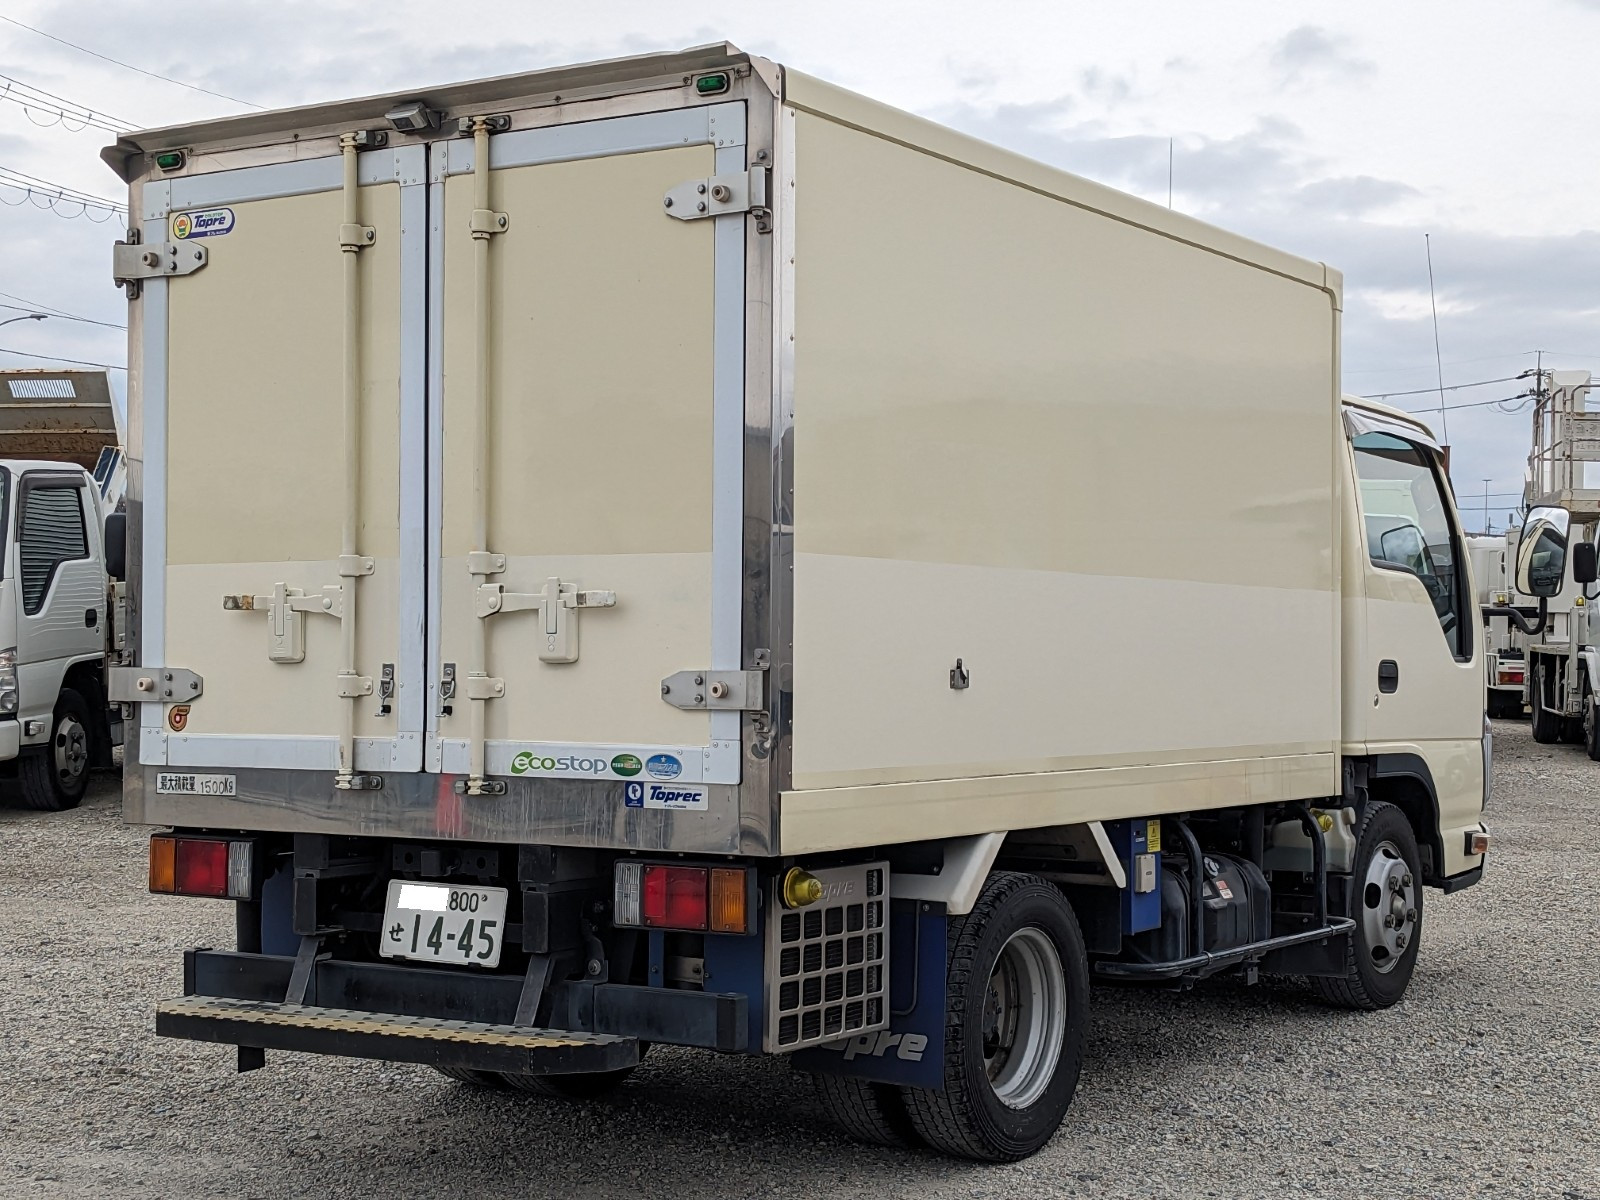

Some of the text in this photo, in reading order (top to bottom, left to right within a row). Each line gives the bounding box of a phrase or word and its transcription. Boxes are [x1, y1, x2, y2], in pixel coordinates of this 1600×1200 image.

[194, 214, 226, 228] Topre
[511, 751, 608, 774] ecostop
[649, 785, 702, 803] Toprec
[449, 891, 479, 913] 800
[389, 914, 497, 960] せ 14-45
[820, 1030, 928, 1062] pre
